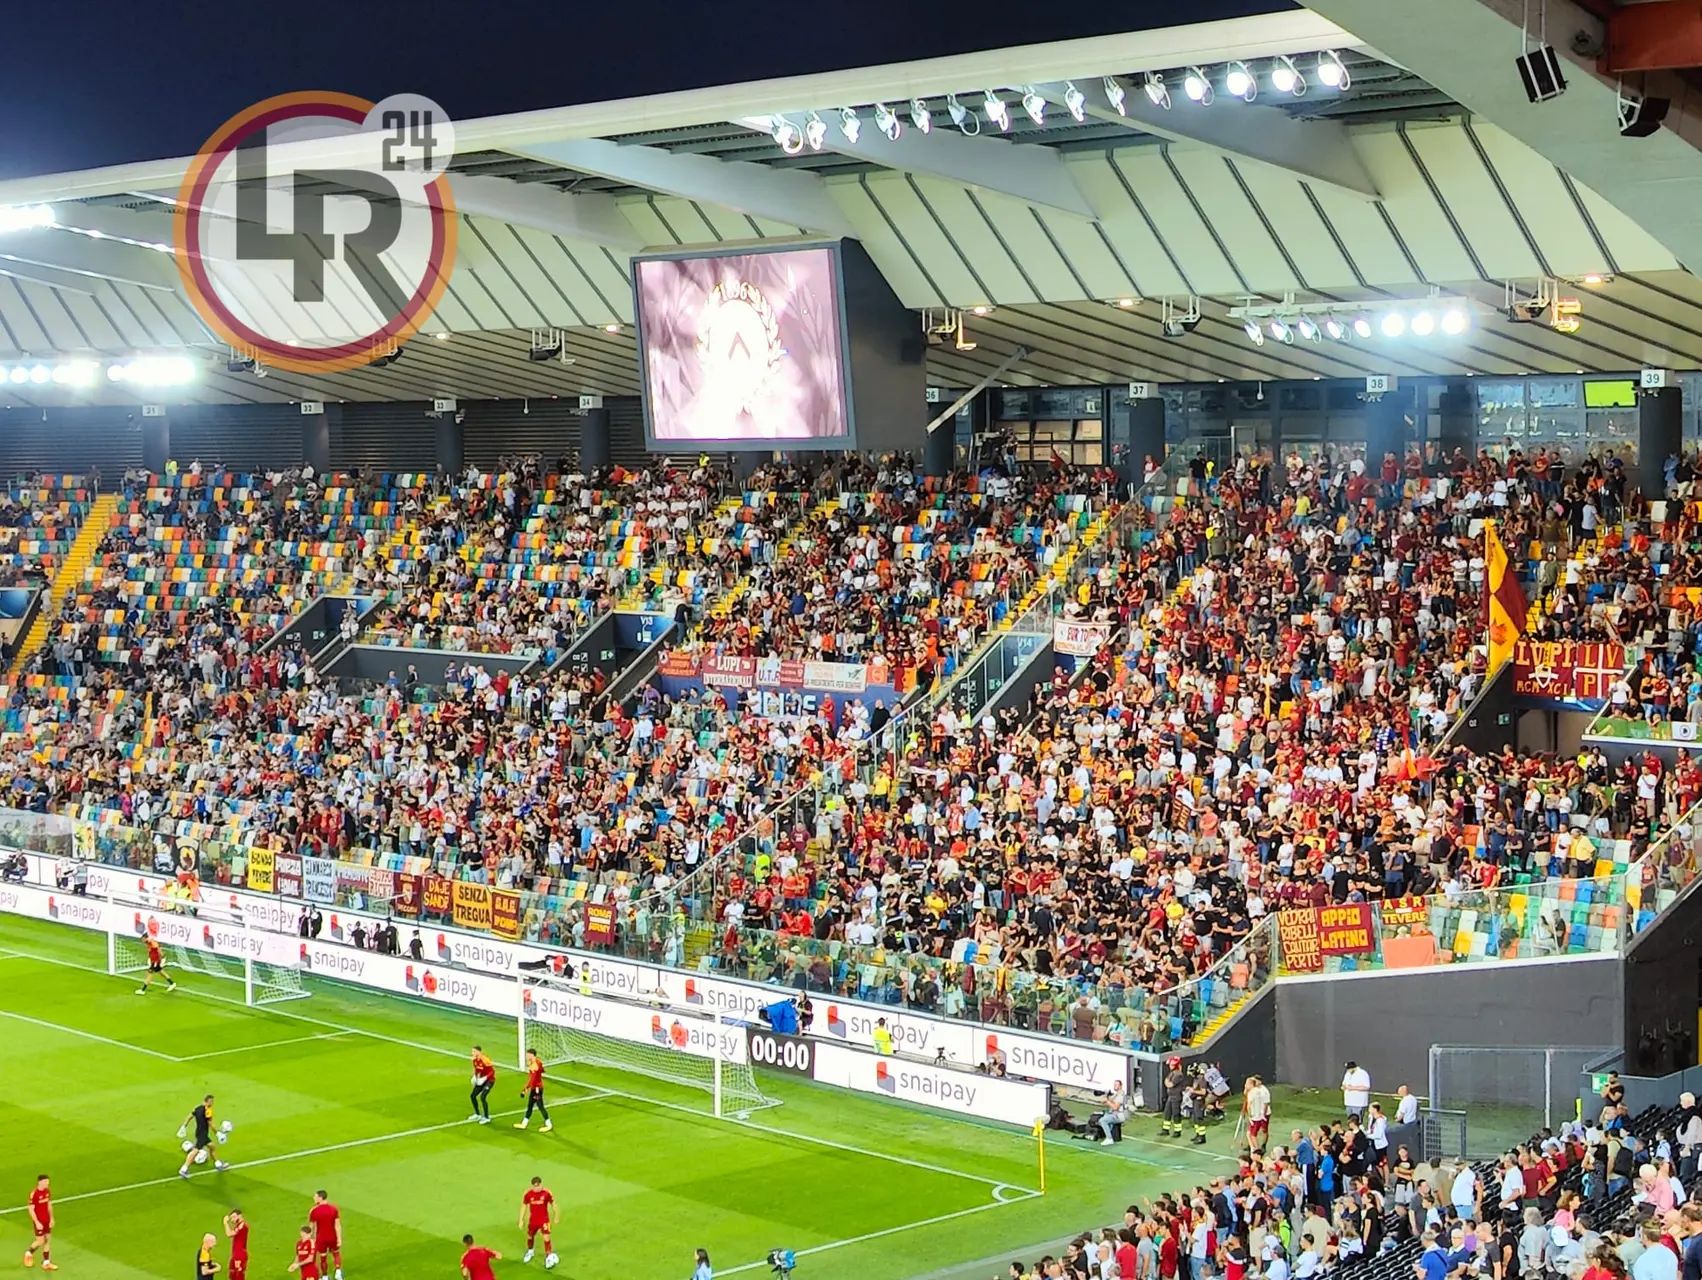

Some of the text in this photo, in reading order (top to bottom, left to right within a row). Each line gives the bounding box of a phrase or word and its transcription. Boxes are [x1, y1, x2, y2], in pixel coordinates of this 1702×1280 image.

[1133, 386, 1144, 395] 37
[1371, 379, 1384, 389] 38
[1646, 374, 1659, 384] 39
[717, 656, 740, 672] LUPI
[459, 885, 487, 903] SENZA
[61, 902, 102, 923] snaipay
[455, 904, 491, 924] TREGUA
[1382, 911, 1426, 924] TEVERE
[160, 920, 192, 942] aipay
[314, 951, 365, 977] snaipay
[455, 940, 513, 970] snaipay
[438, 975, 477, 1001] aipay
[573, 964, 636, 992] saipay
[541, 997, 602, 1027] snaipay
[707, 988, 770, 1015] snaipa
[689, 1026, 738, 1055] aipay
[851, 1015, 929, 1050] snipay
[752, 1035, 809, 1071] 00:00
[1012, 1046, 1098, 1082] snaipay
[900, 1072, 976, 1106] snaipay
